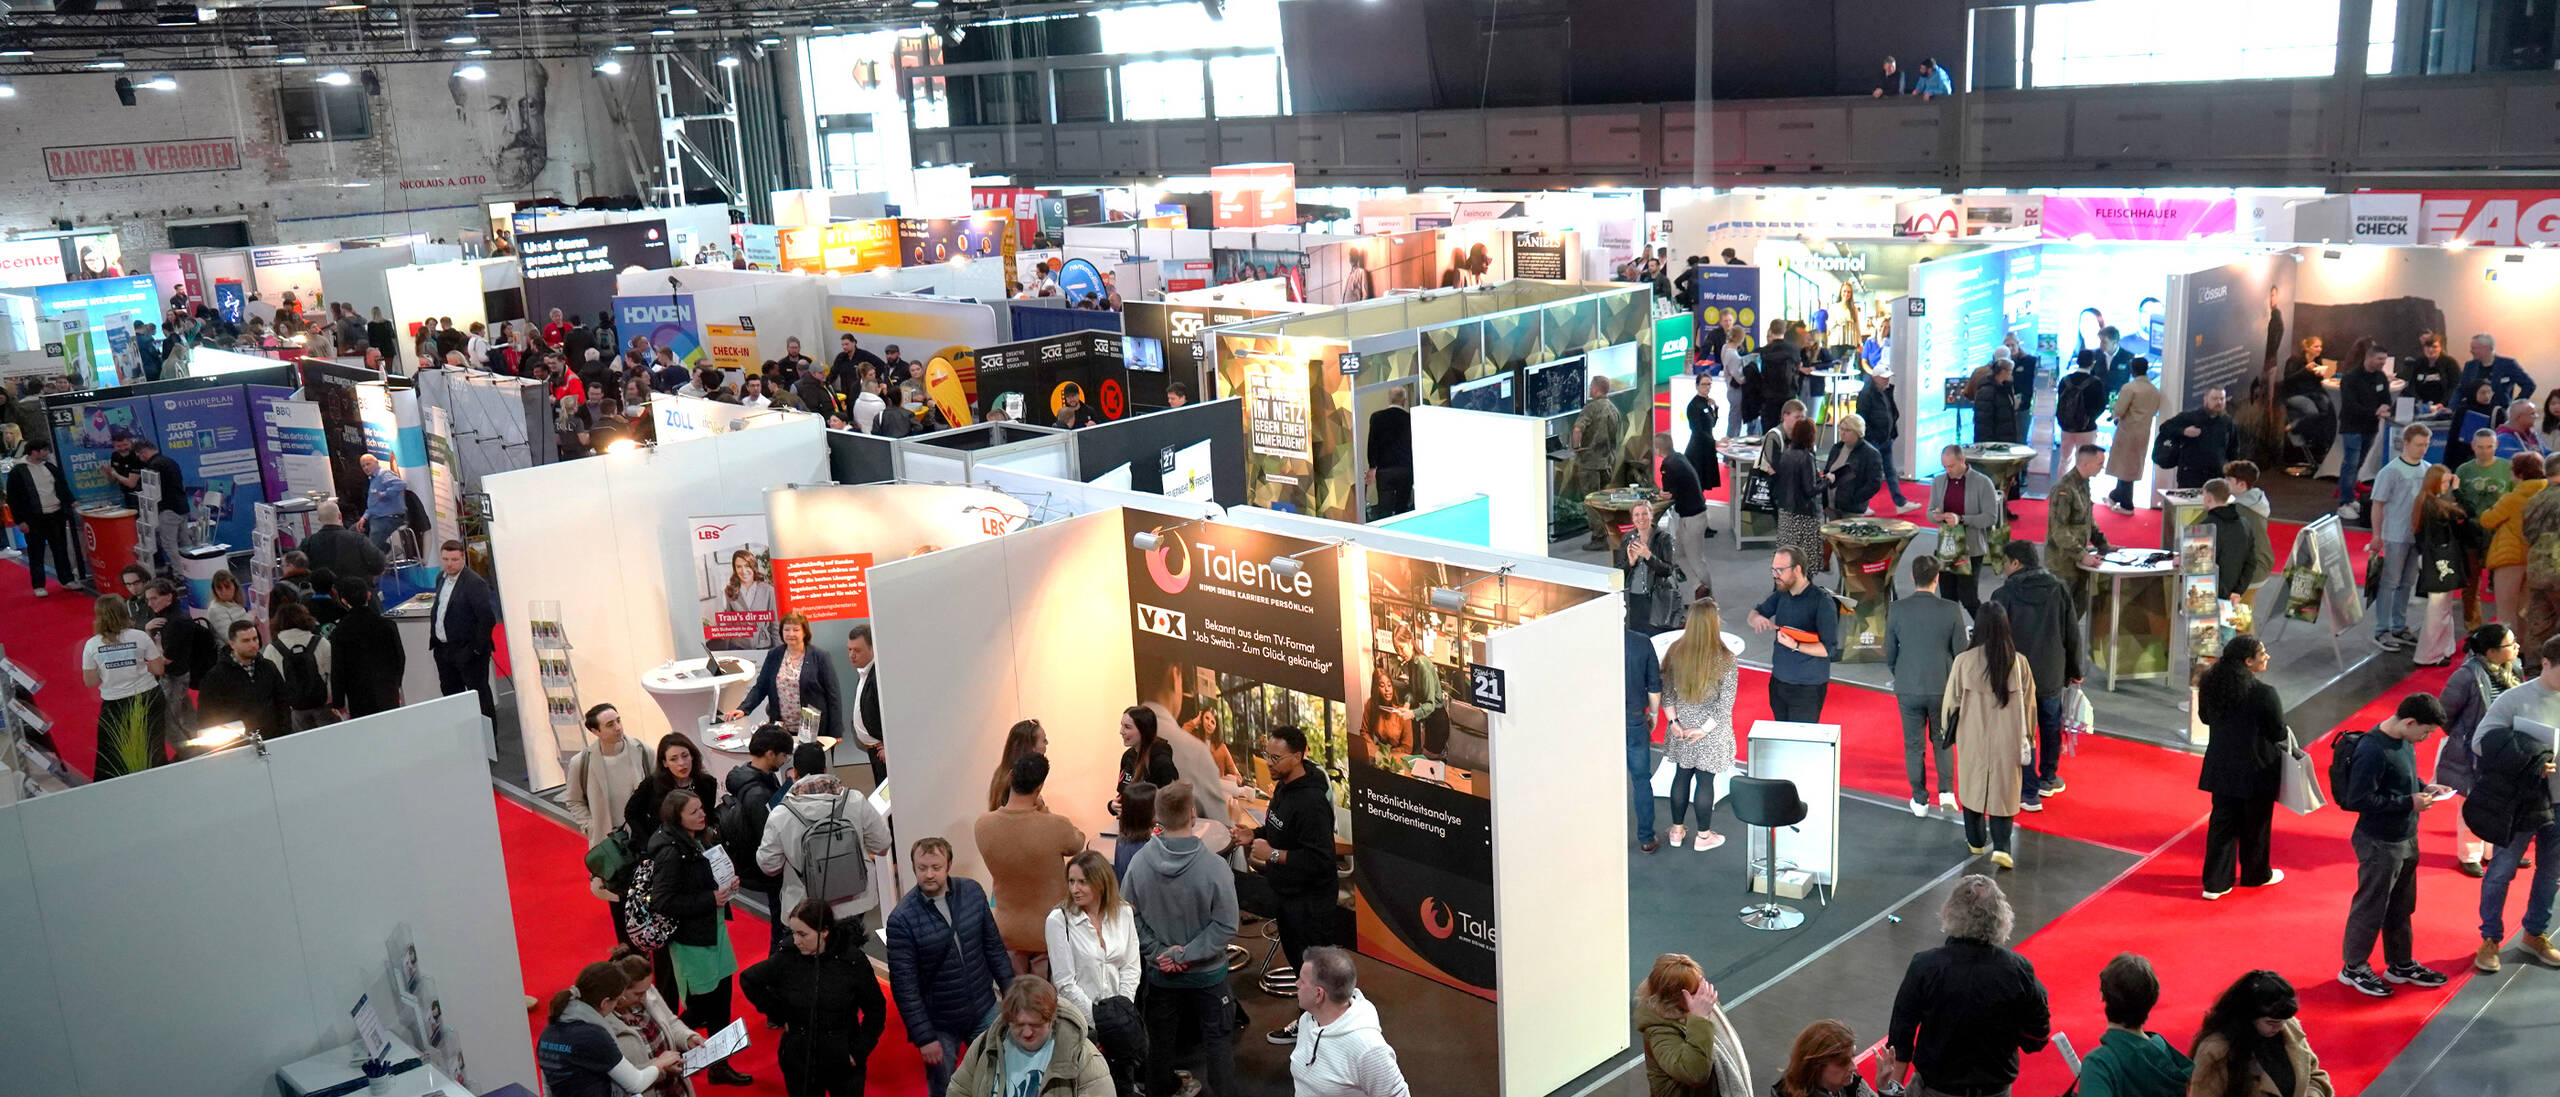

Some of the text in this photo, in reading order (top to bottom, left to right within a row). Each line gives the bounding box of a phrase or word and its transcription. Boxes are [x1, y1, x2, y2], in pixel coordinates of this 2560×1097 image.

[50, 142, 236, 176] RAUCHEN VERBOTEN
[400, 176, 445, 190] NICOLAUS
[459, 175, 486, 185] OTTO
[2096, 208, 2177, 218] FLEISCHHAUER
[2356, 223, 2408, 236] CHECK
[524, 238, 589, 254] Und dann
[1704, 292, 1715, 300] Wir
[1716, 292, 1738, 301] bieten
[1911, 302, 1924, 312] 62
[624, 304, 692, 324] HOWDEN
[48, 345, 61, 354] 09
[713, 346, 749, 357] CHECK-IN
[1192, 346, 1204, 356] 29
[1342, 358, 1360, 370] 25
[178, 395, 233, 408] FUTUREPLAN
[54, 411, 73, 423] 13
[276, 406, 292, 417] BBQ
[1253, 399, 1304, 424] IM NETZ
[166, 420, 197, 431] JEDES
[666, 409, 694, 430] ZOLL
[168, 430, 193, 440] JAHR
[1254, 420, 1305, 437] GEGEN EINEN
[1255, 432, 1305, 450] KAMERADEN?
[70, 452, 97, 462] DEIN
[1163, 453, 1174, 467] 27
[982, 517, 1006, 536] LBS
[699, 531, 720, 540] LBS
[1199, 583, 1314, 614] NIMM DEINE KARRIERE PERSÖNLICH
[718, 612, 772, 622] Trau's dir zu!
[1204, 618, 1315, 653] Bekannt aus dem TV-Format
[1210, 636, 1235, 650] Switch
[1242, 642, 1261, 656] Zum
[1262, 647, 1286, 662] Glück
[1475, 675, 1502, 701] 21
[1367, 788, 1461, 825] Persönlichkeitsanalyse
[1368, 803, 1446, 838] Berufsorientierung
